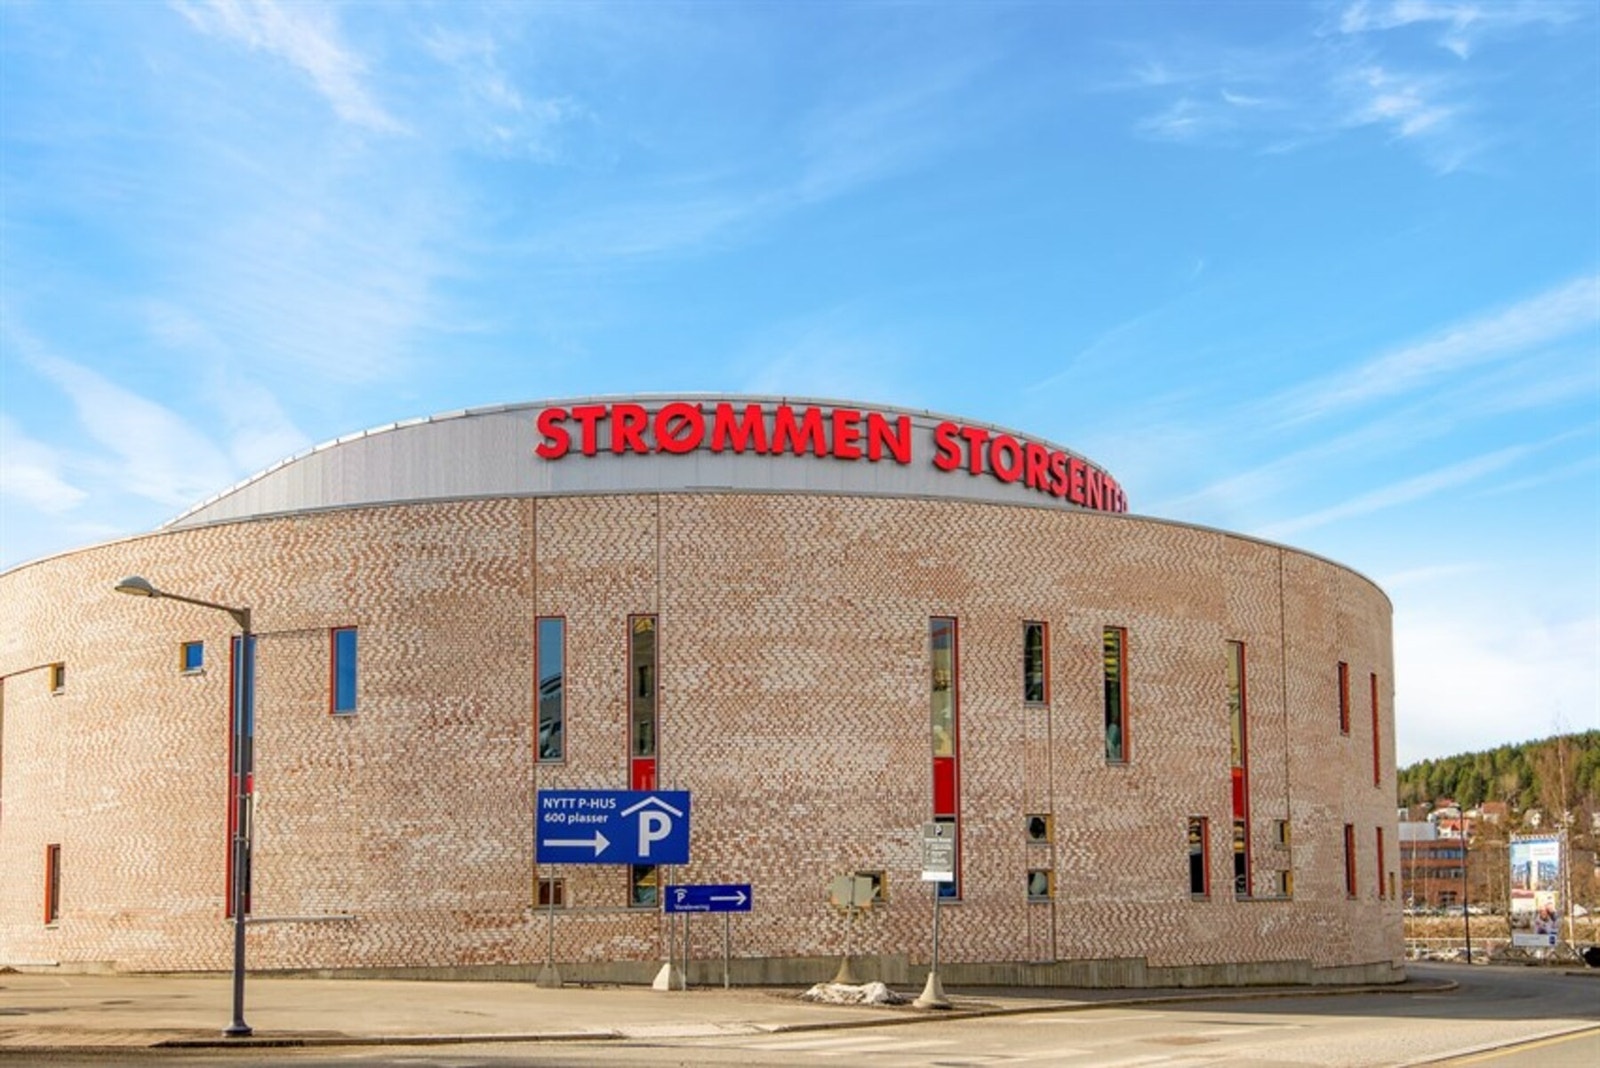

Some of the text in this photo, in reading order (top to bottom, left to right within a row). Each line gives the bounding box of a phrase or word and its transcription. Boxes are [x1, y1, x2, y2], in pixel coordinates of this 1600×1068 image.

[535, 402, 912, 464] STRØMMEN
[543, 798, 616, 809] NYTT P-HUS
[544, 812, 608, 825] 600 plasser
[638, 810, 672, 857] P
